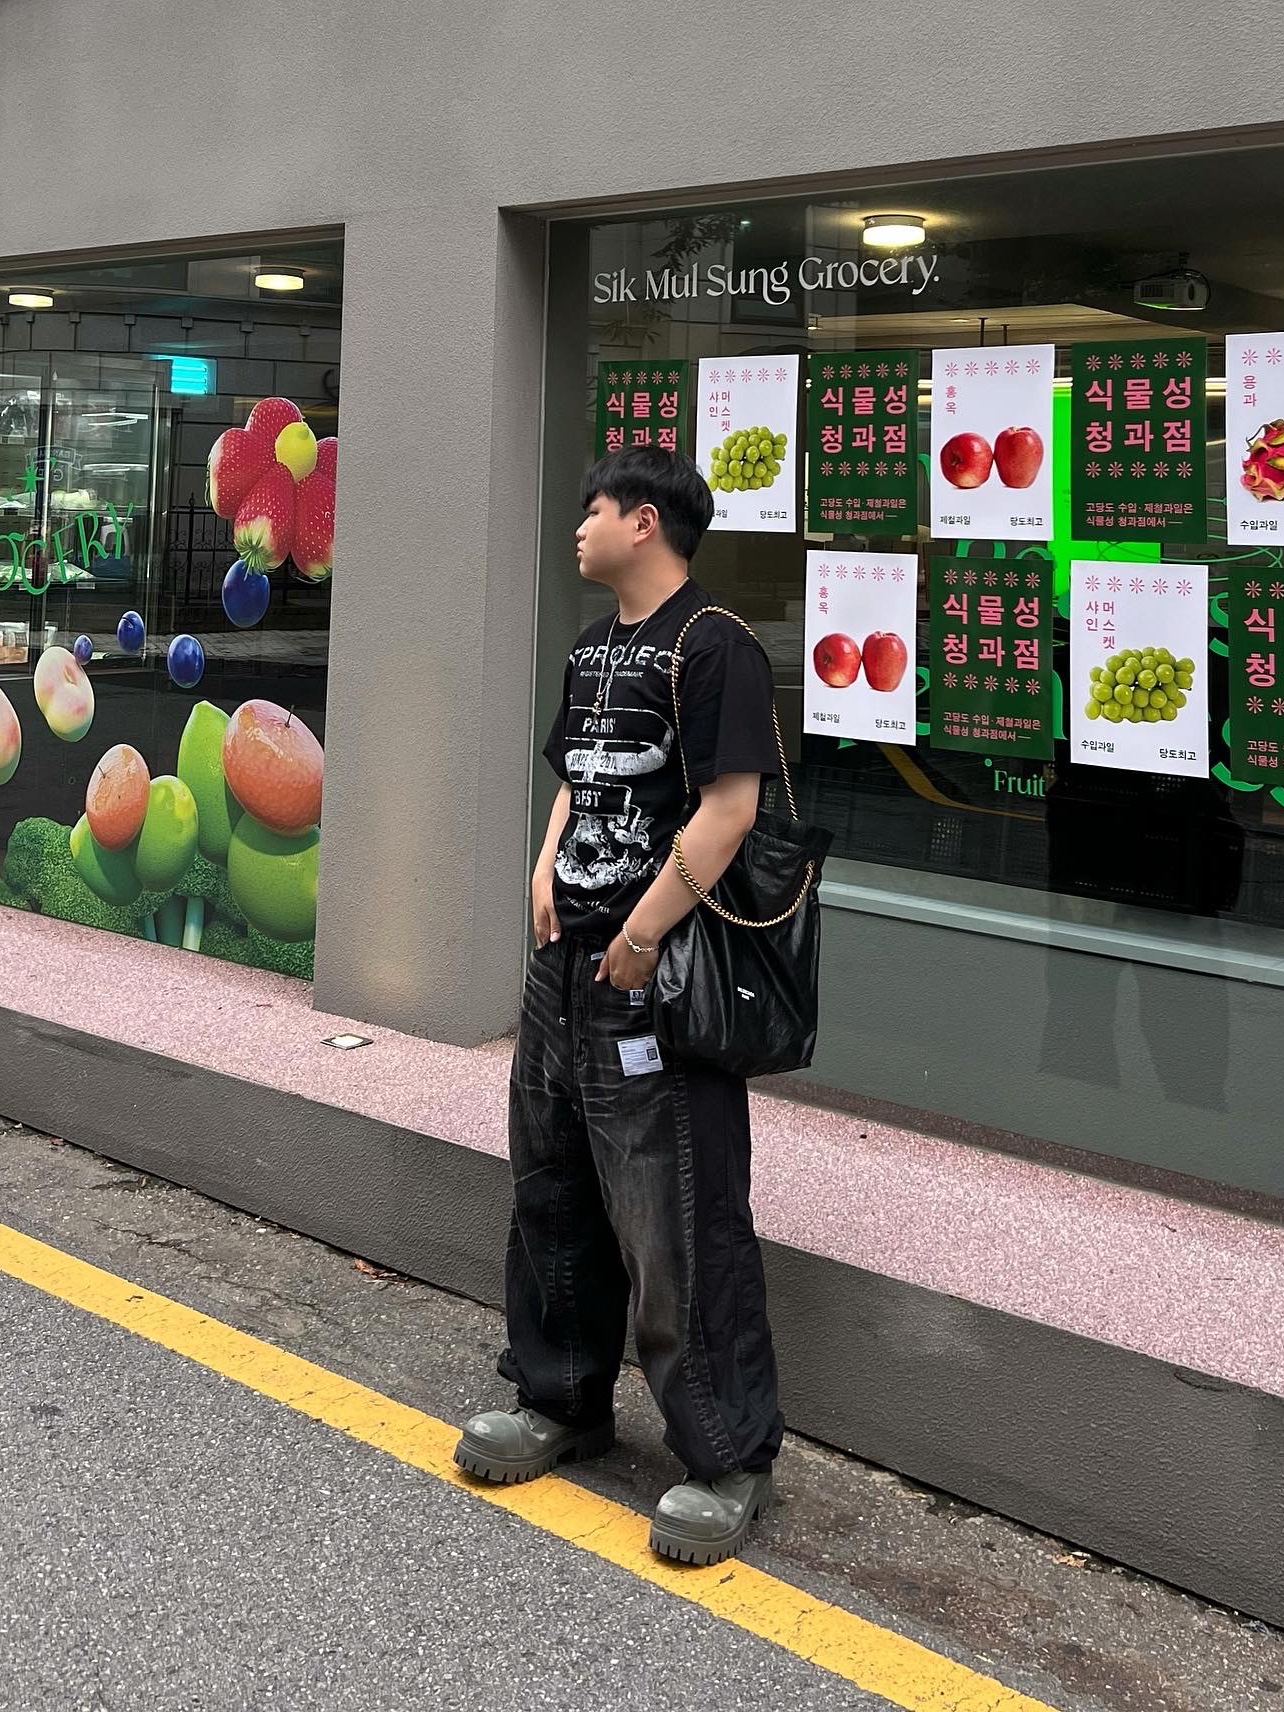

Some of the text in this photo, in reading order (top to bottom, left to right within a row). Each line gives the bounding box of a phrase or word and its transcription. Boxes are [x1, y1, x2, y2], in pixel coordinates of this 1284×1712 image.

[594, 255, 939, 305] Sik Mul Sung Grocery.
[606, 391, 678, 419] 식물성
[820, 384, 907, 416] 식물성
[1085, 377, 1192, 412] 식물성
[820, 424, 907, 454] 청과점
[1085, 420, 1192, 453] 청과점
[760, 510, 788, 520] 당도최고
[1086, 502, 1115, 513] 고당도
[1010, 516, 1043, 527] 당도최고
[1086, 515, 1114, 527] 식물성
[1239, 519, 1278, 531] 수입과일
[943, 595, 1040, 629] 식물성
[943, 634, 1040, 671] 청과점
[875, 718, 906, 730] 당도최고
[1081, 739, 1115, 753] 수입과일
[1159, 748, 1197, 761] 당도최고
